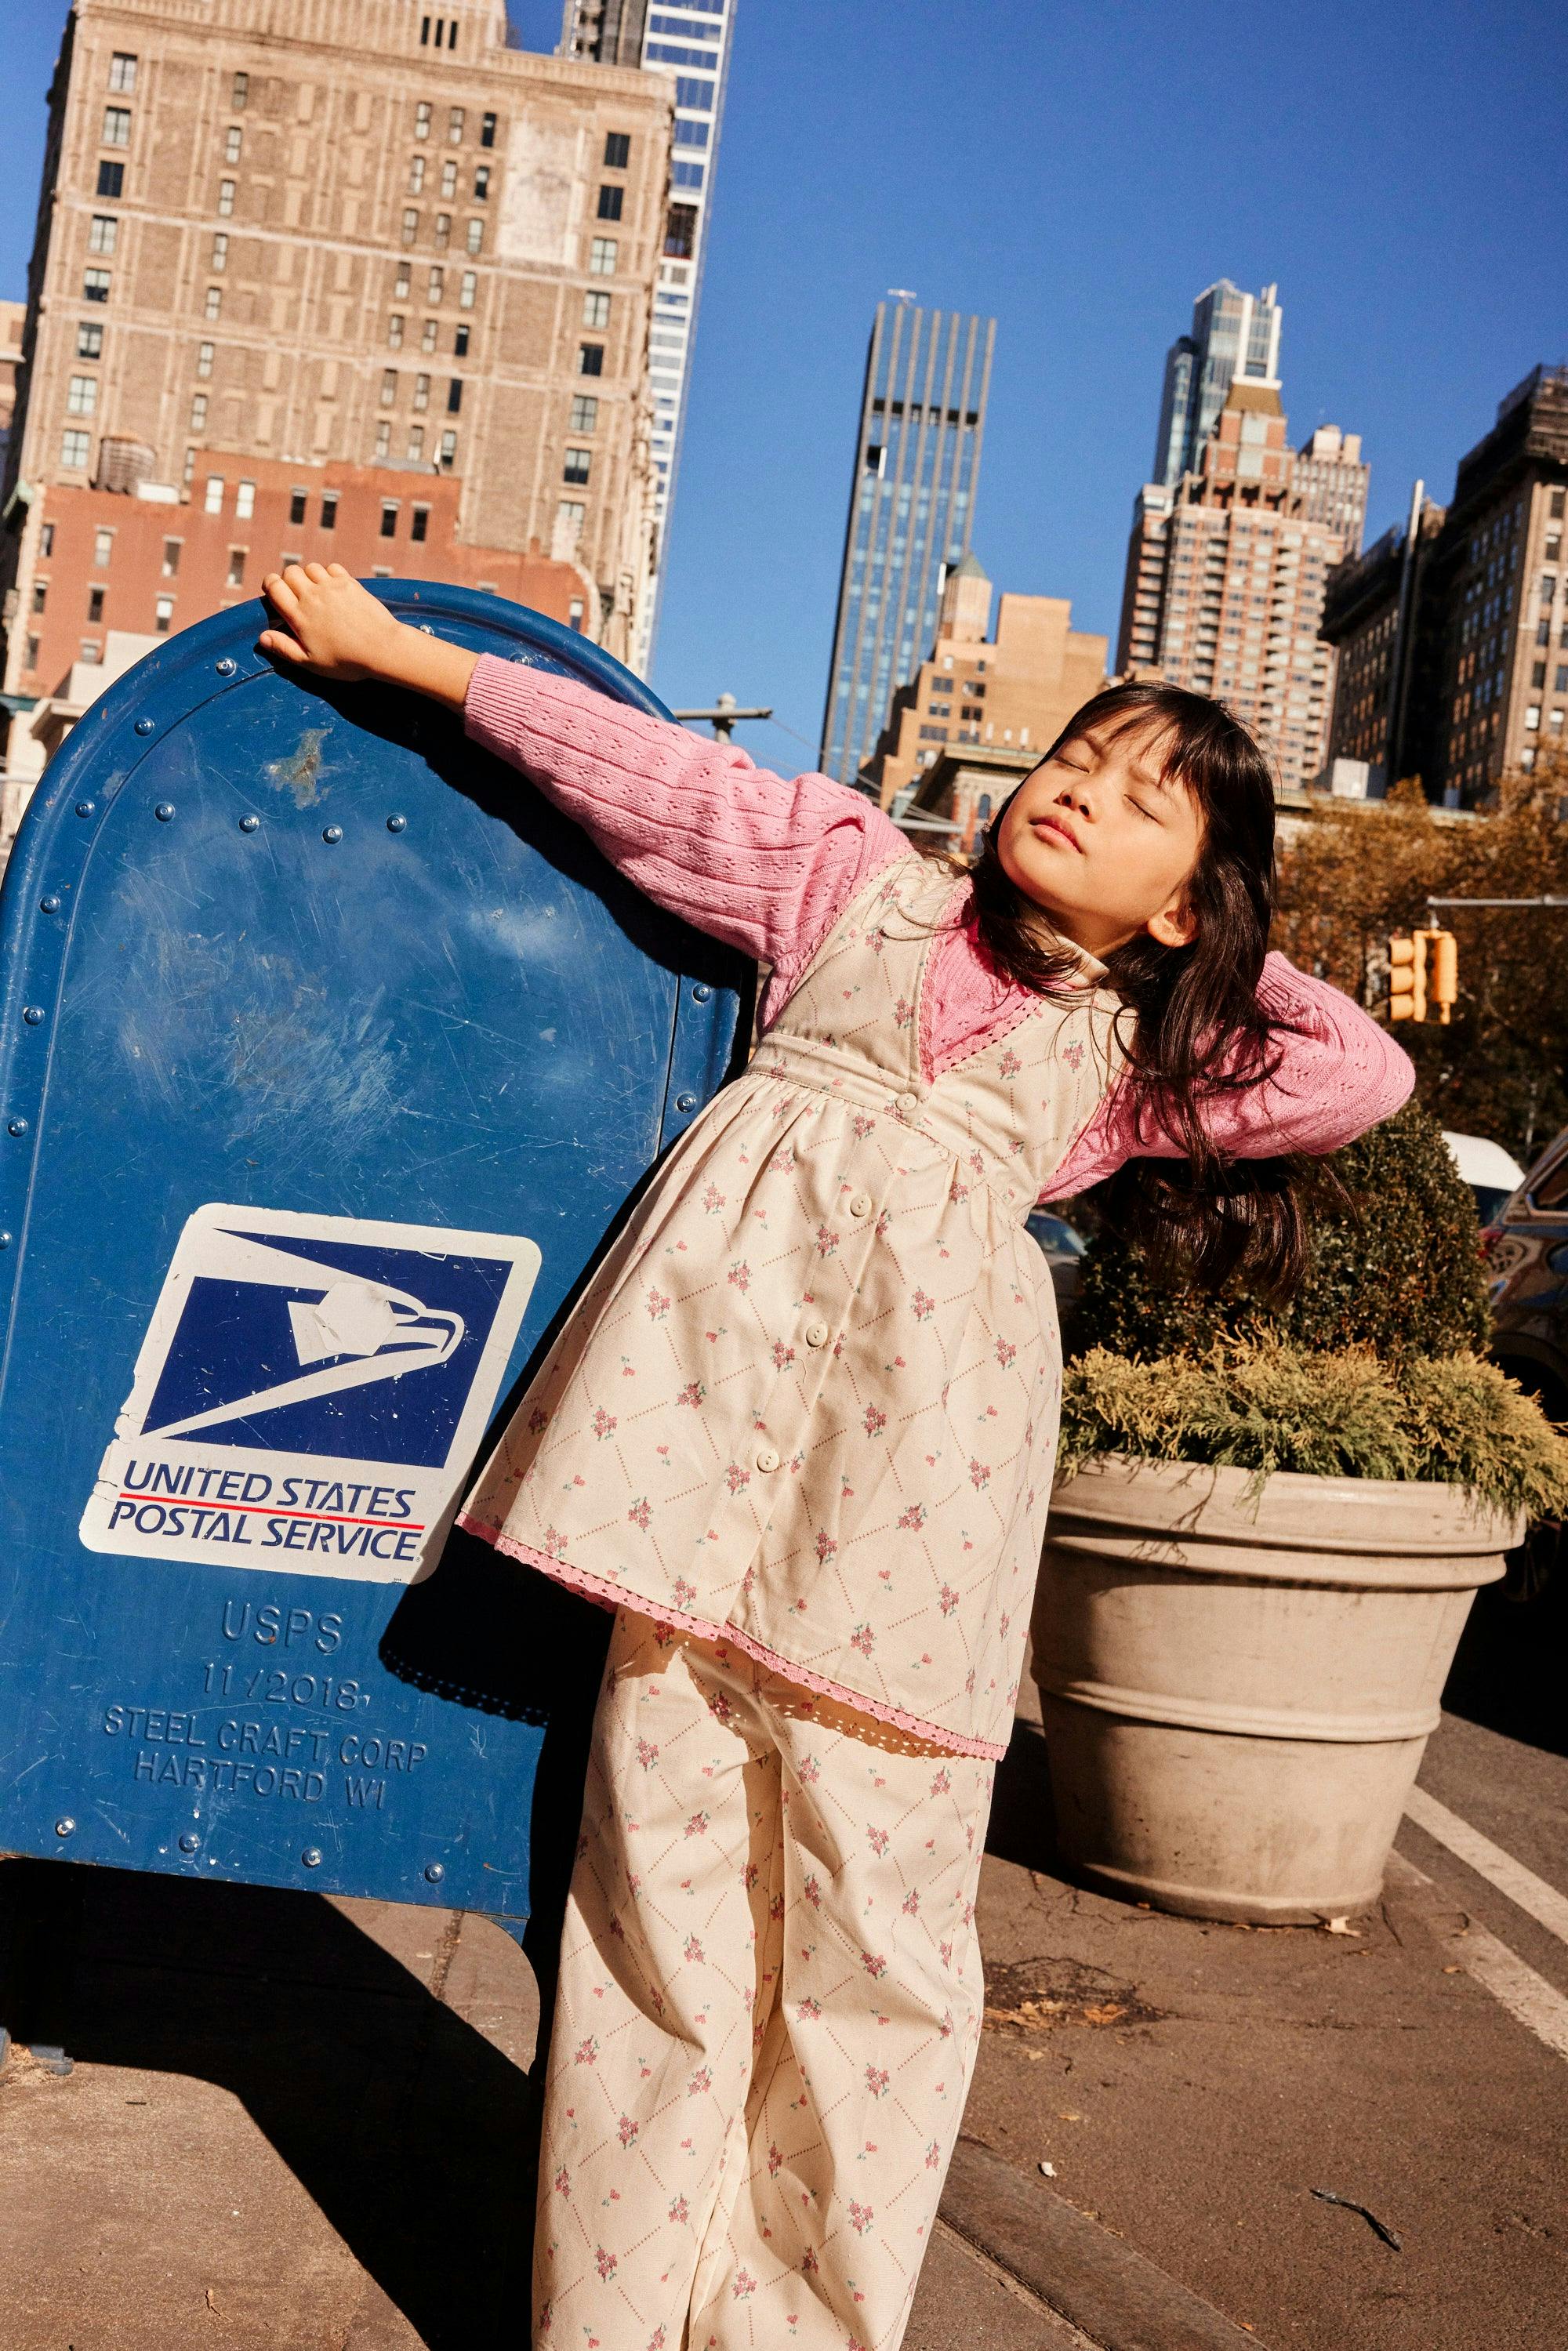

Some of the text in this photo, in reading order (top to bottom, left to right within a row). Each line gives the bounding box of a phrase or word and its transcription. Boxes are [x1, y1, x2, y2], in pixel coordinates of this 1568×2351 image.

[124, 1460, 416, 1518] UNITED STATES
[107, 1501, 422, 1562] POSTAL SERVICE
[222, 1600, 343, 1653] USPS
[104, 1704, 428, 1772] STEEL CRAFT CORP
[134, 1750, 387, 1809] HARTFORD WI
